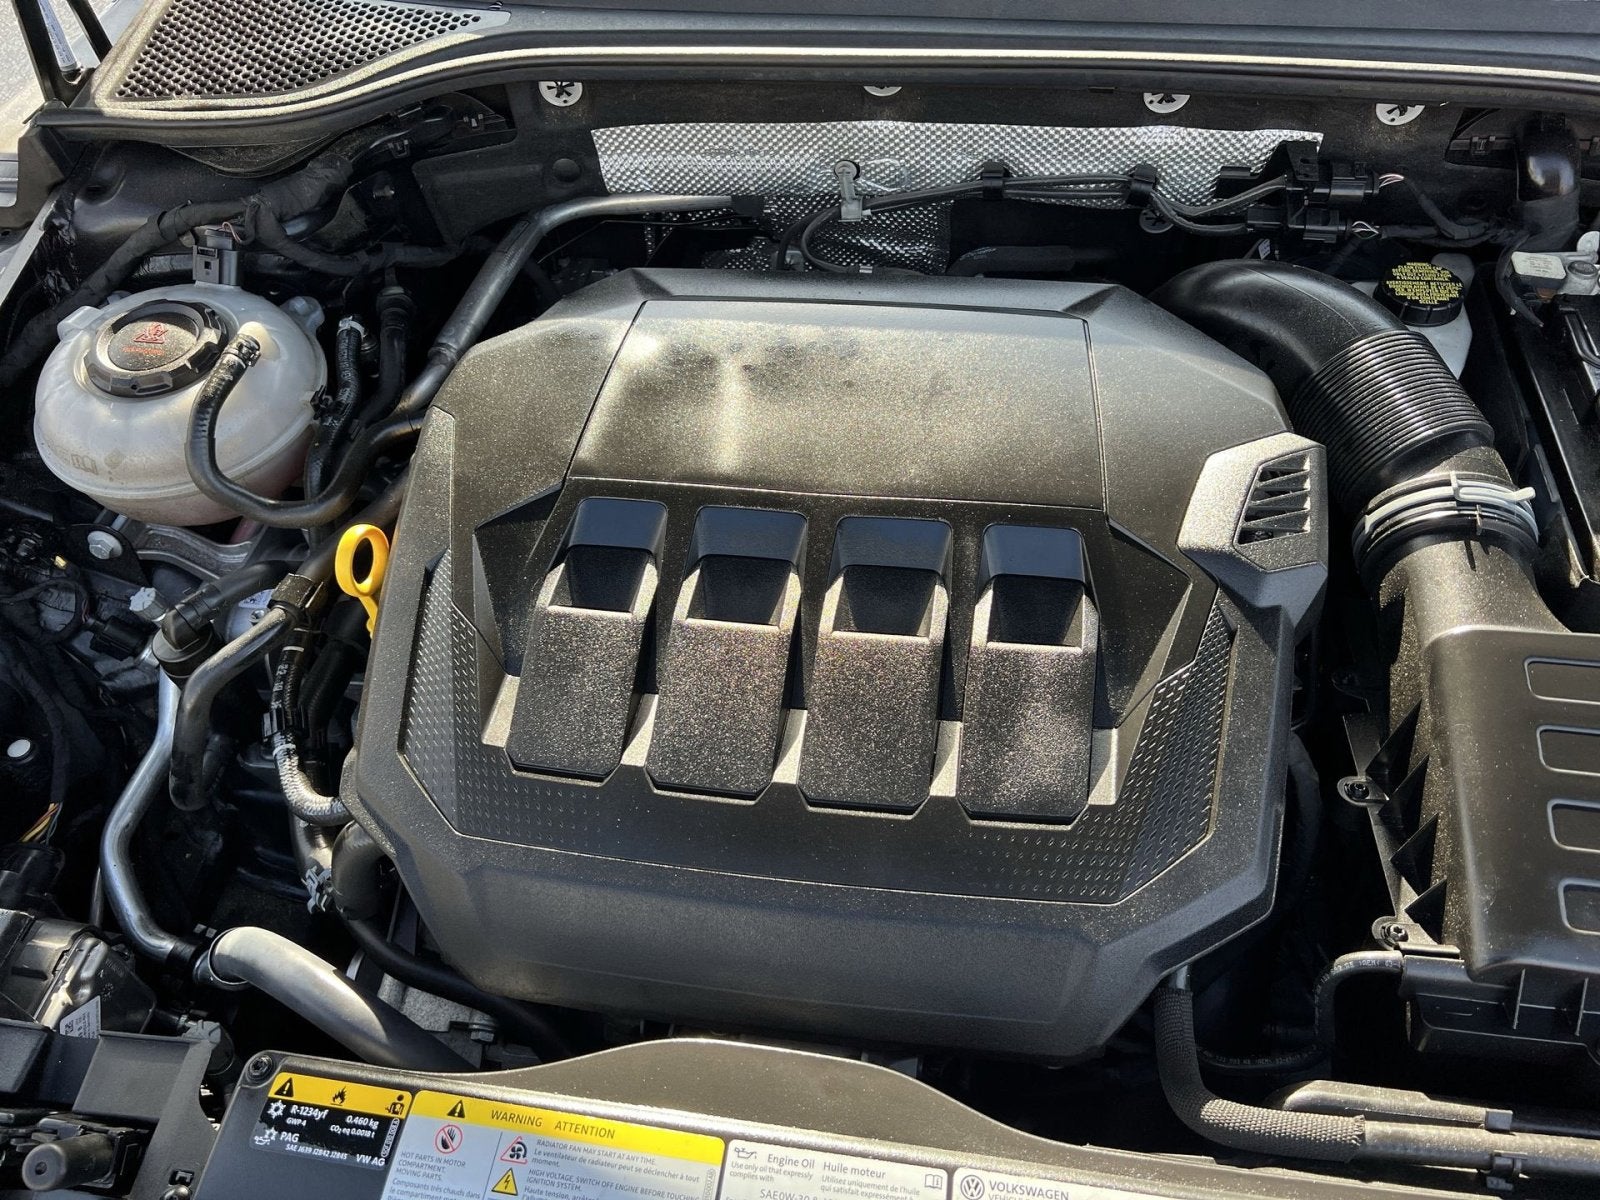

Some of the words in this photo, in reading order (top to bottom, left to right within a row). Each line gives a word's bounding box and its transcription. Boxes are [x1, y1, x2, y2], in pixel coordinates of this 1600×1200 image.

[290, 1104, 329, 1120] R-1234yf
[346, 1115, 368, 1126] 0.460
[368, 1118, 379, 1130] kg
[491, 1109, 543, 1127] WARNING
[554, 1120, 616, 1139] ATTENTION
[280, 1131, 300, 1143] PAG
[536, 1139, 568, 1150] RADIATOR
[568, 1144, 581, 1152] FAN
[582, 1146, 597, 1155] MAY
[597, 1149, 617, 1158] START
[617, 1152, 625, 1160] AT
[355, 1153, 371, 1165] VW
[371, 1156, 386, 1166] AG
[400, 1151, 414, 1159] HOT
[414, 1153, 435, 1162] PARTS
[443, 1157, 466, 1167] MOTOR
[543, 1150, 579, 1162] ventilateur
[587, 1158, 619, 1169] radiateur
[619, 1163, 634, 1173] peut
[643, 1166, 679, 1179] déclencher
[685, 1175, 700, 1183] tout
[767, 1153, 799, 1168] Engine
[801, 1158, 815, 1169] Oil
[823, 1161, 848, 1174] Huile
[850, 1167, 886, 1179] moteur
[395, 1167, 421, 1178] MOVING
[729, 1170, 758, 1181] complies
[759, 1174, 775, 1182] with
[731, 1161, 743, 1169] Use
[744, 1163, 758, 1173] only
[768, 1166, 782, 1175] that
[782, 1169, 813, 1181] expressly
[392, 1177, 429, 1192] Composants
[526, 1176, 555, 1187] IGNITION
[528, 1168, 545, 1177] HIGH
[576, 1176, 601, 1187] SWITCH
[601, 1181, 615, 1189] OFF
[615, 1183, 638, 1194] ENGINE
[639, 1188, 665, 1198] BEFORE
[821, 1175, 846, 1185] Utilisez
[847, 1179, 889, 1190] uniquement
[524, 1185, 543, 1195] Haute
[820, 1184, 831, 1193] qui
[832, 1185, 859, 1196] satisfait
[989, 1179, 1069, 1200] VOLKSWAGEN
